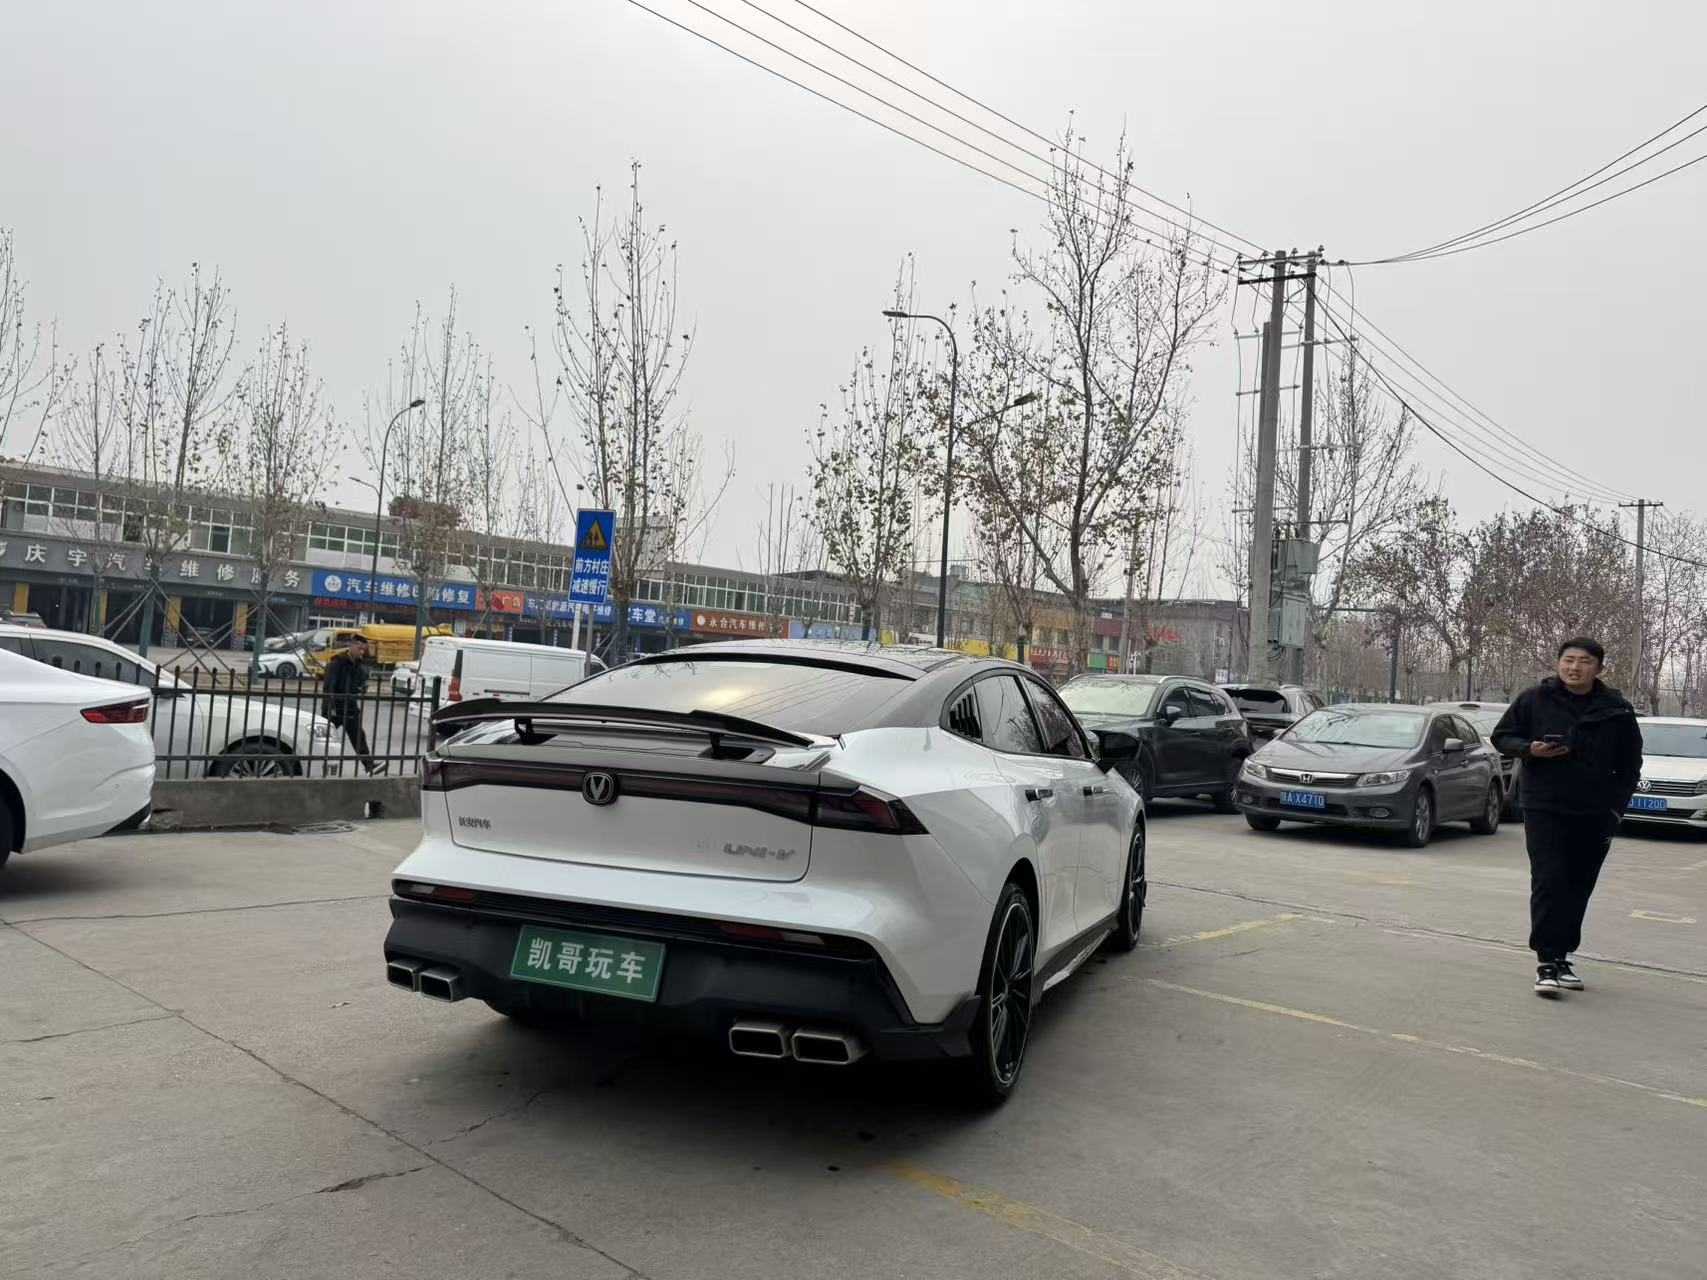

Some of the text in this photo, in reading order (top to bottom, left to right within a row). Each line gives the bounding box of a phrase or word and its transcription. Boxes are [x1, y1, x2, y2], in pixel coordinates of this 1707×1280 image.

[0, 542, 300, 588] 庆宇汽维修务
[575, 558, 609, 575] 前方村庄
[527, 937, 646, 984] 凯哥玩车
